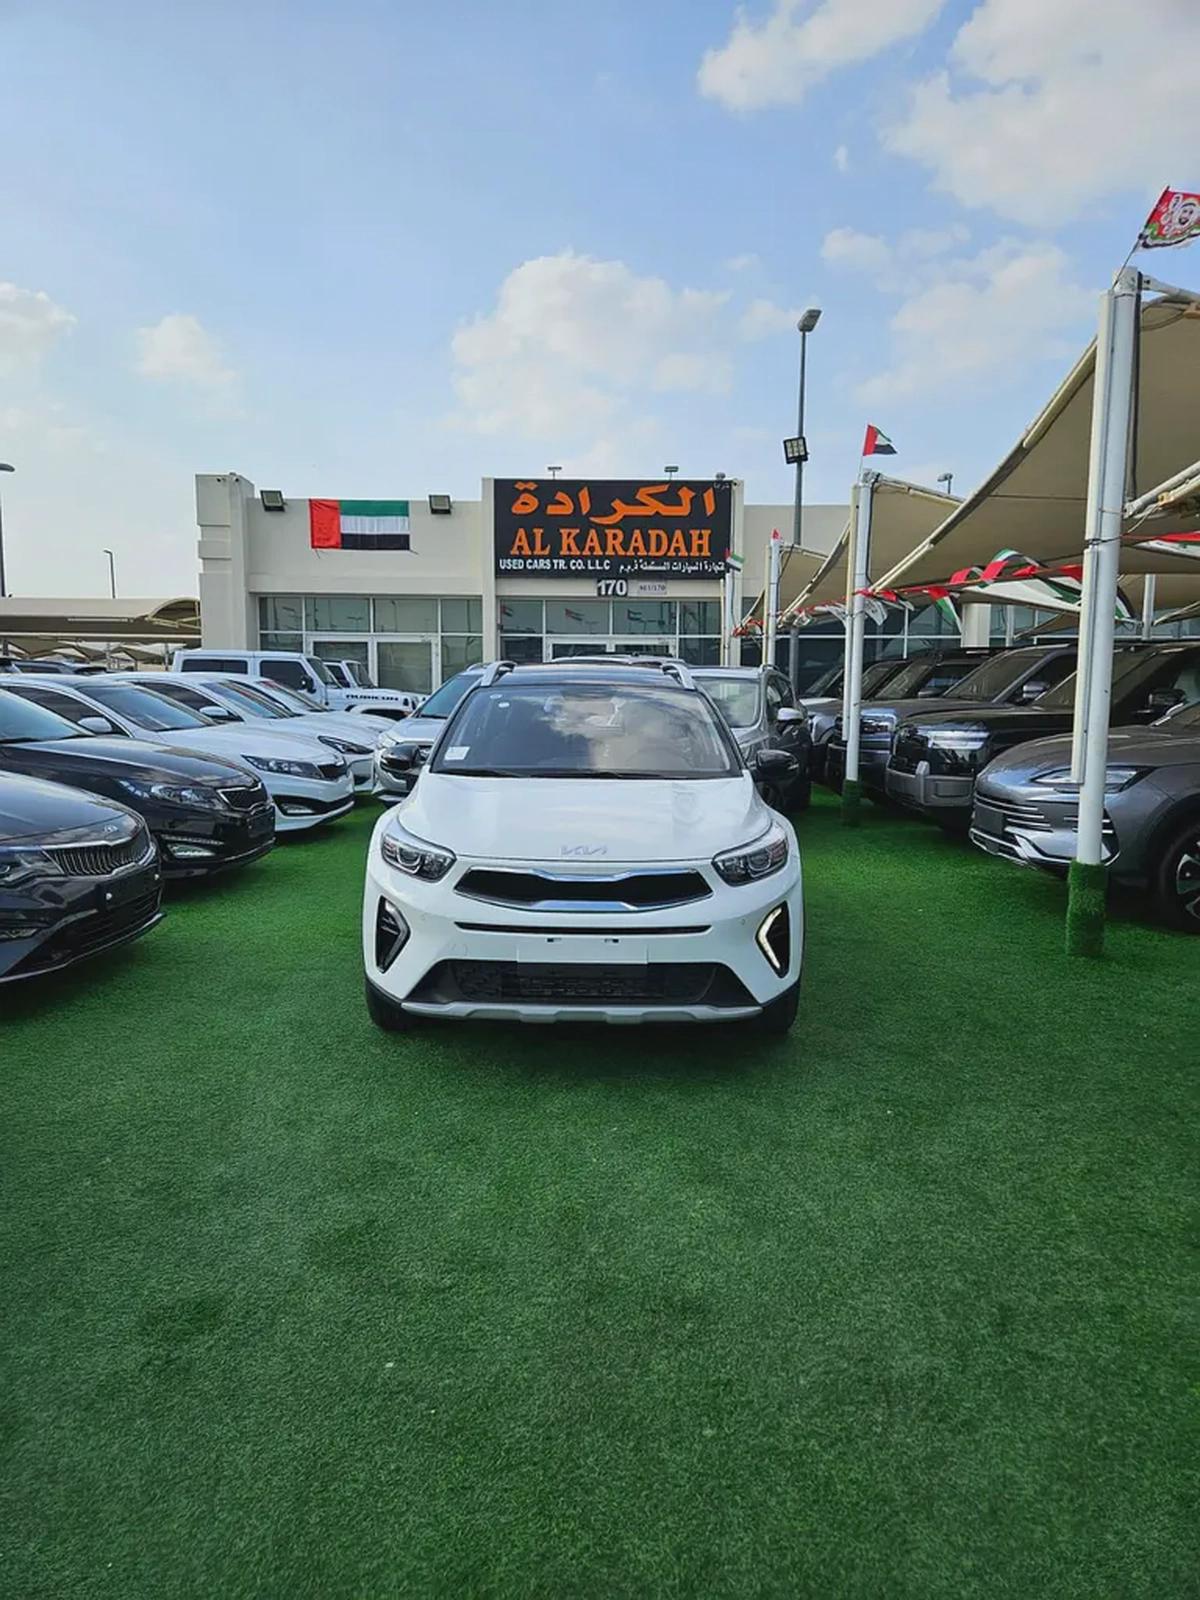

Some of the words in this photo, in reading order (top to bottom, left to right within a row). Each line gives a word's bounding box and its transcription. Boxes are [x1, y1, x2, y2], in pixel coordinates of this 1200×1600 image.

[511, 481, 716, 525] الكرادة
[510, 528, 550, 555] AL
[559, 528, 712, 557] KARADAH
[499, 559, 524, 570] USED
[526, 559, 551, 570] CARS
[553, 559, 568, 570] TR.
[569, 559, 586, 570] CO.
[671, 560, 702, 574] السيارات
[704, 560, 725, 574] تجارة
[597, 579, 628, 596] 170
